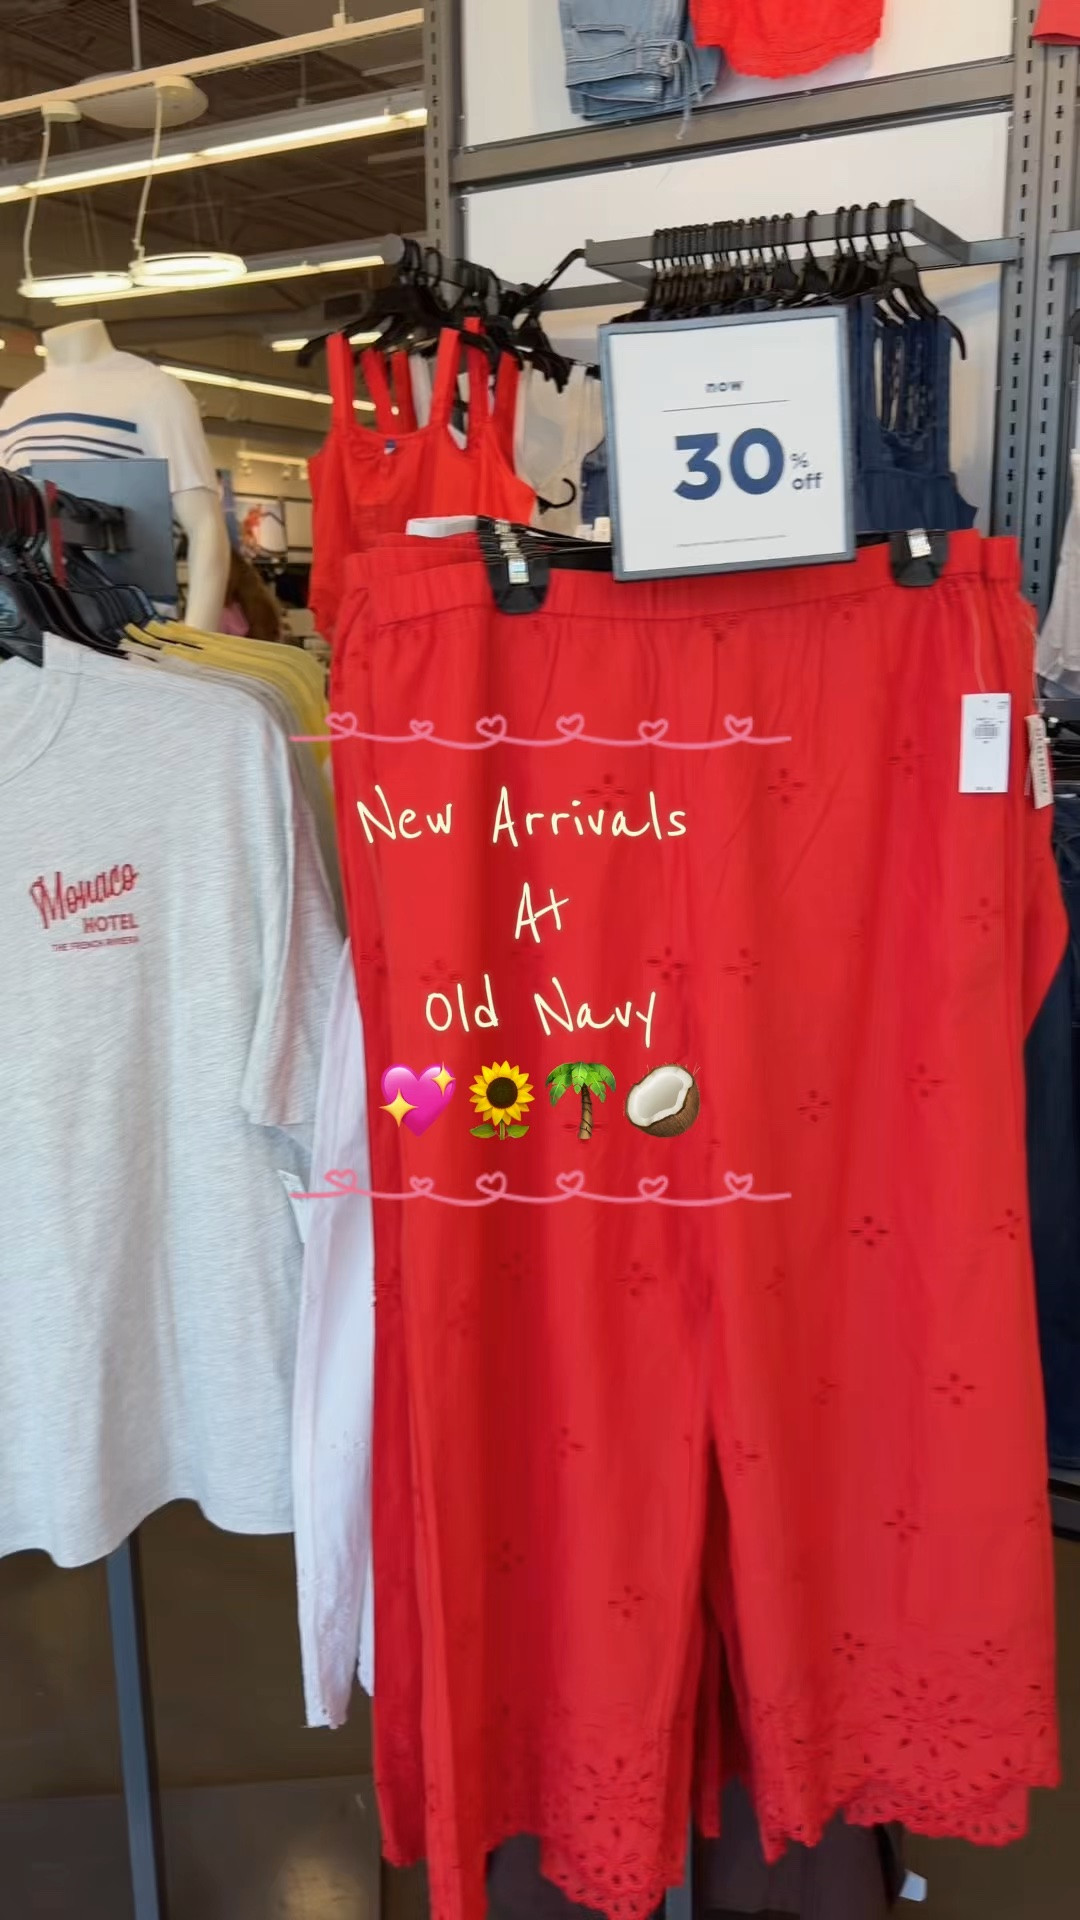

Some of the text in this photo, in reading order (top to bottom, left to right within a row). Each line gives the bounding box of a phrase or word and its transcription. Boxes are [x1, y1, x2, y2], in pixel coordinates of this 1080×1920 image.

[705, 380, 744, 393] now
[674, 427, 785, 501] 30
[792, 472, 823, 491] off
[29, 863, 140, 930] Monaco
[82, 912, 140, 934] HOTEL
